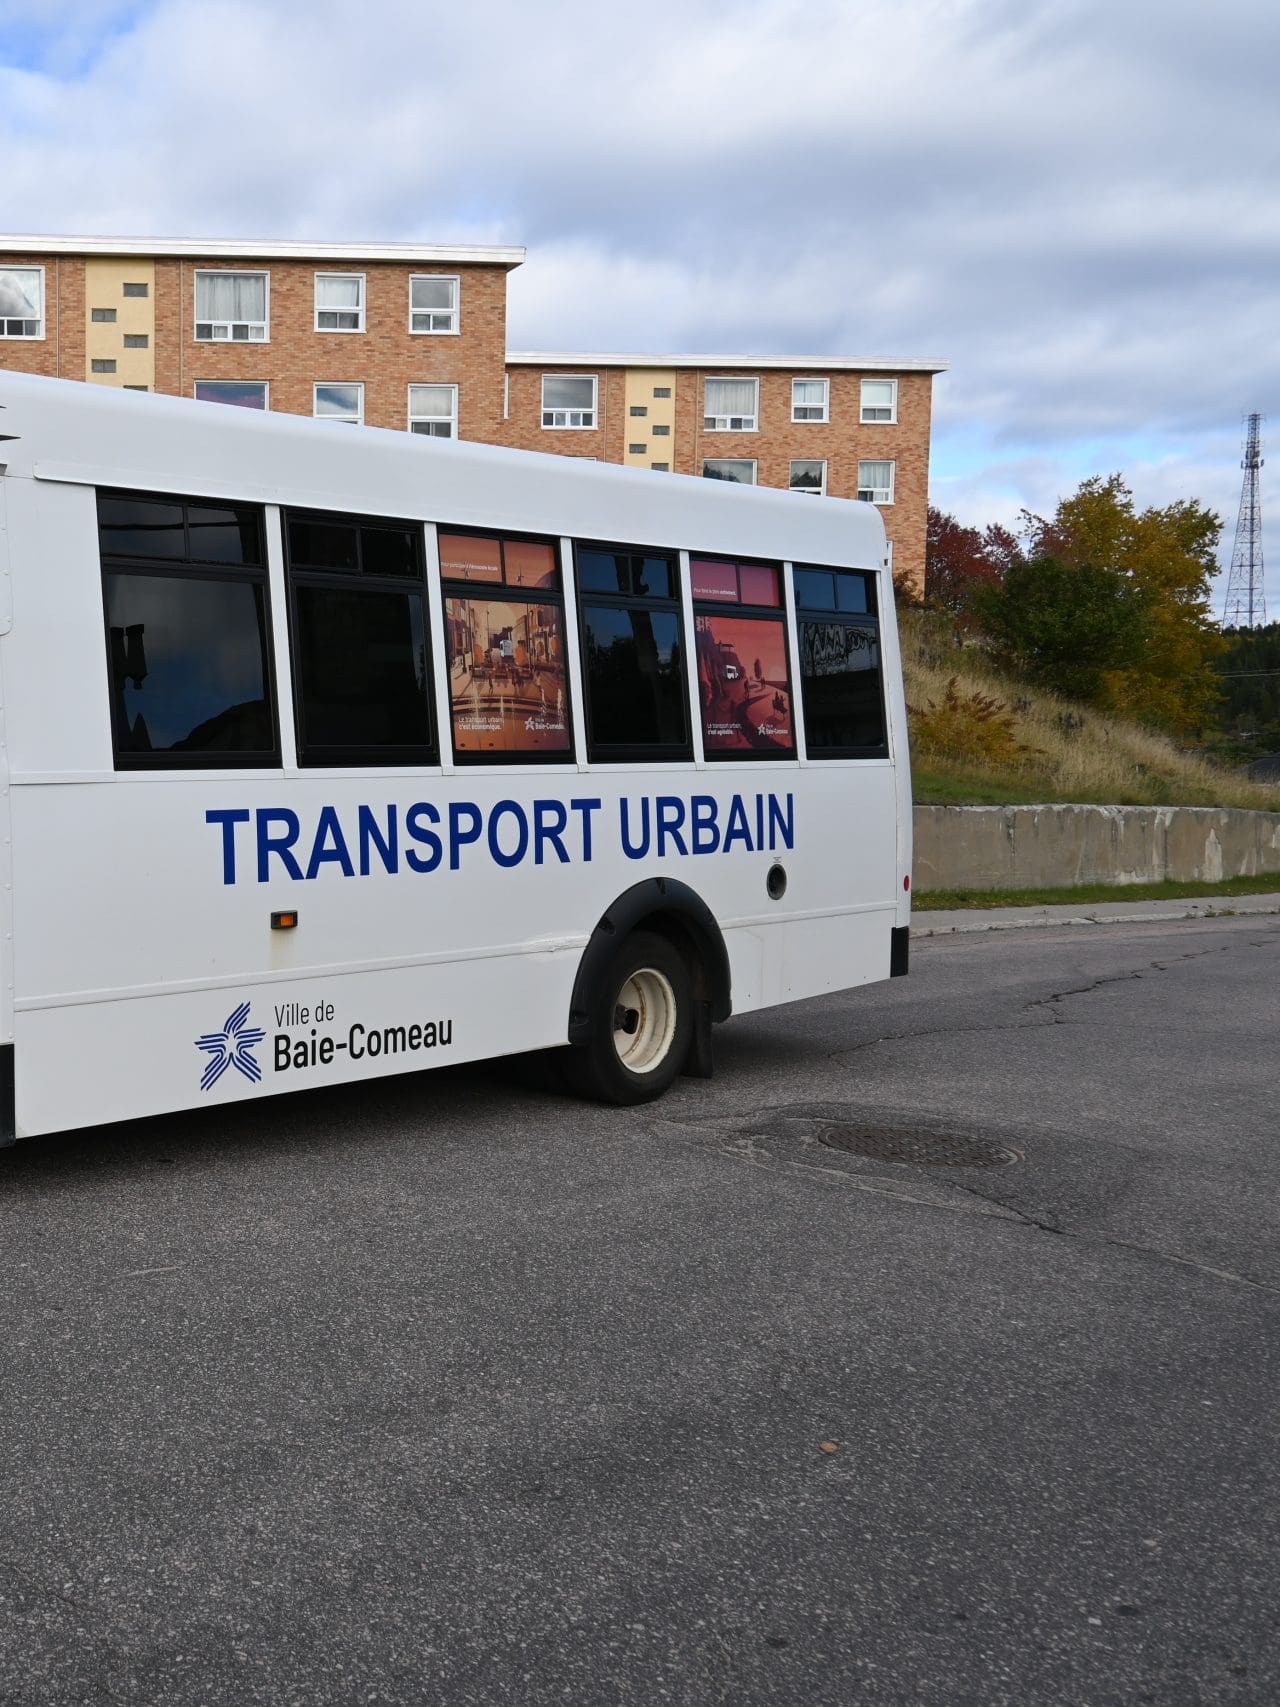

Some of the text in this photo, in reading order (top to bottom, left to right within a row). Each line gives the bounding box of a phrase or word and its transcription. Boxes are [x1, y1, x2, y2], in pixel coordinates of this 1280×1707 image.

[205, 793, 794, 885] TRANSPORT URBAIN
[274, 999, 335, 1028] Ville de
[274, 1019, 453, 1072] Baie-Comeau
